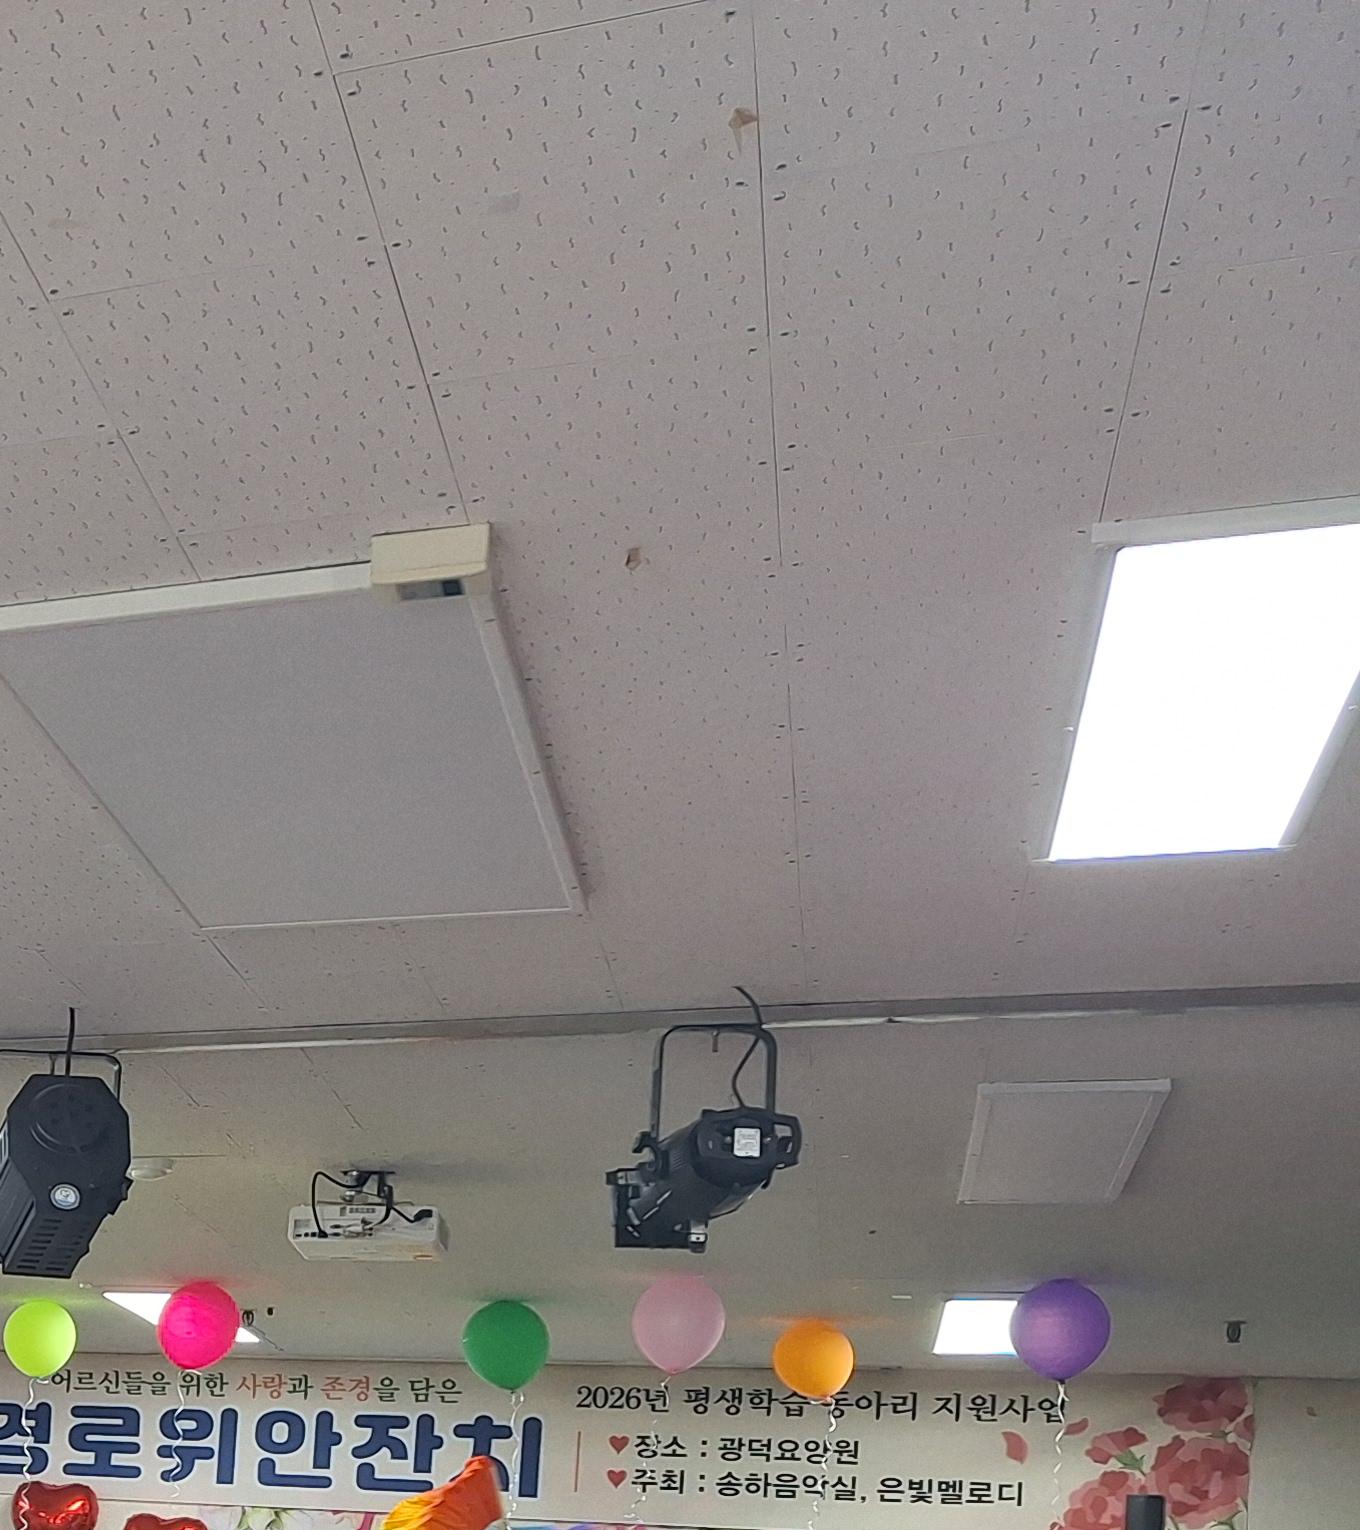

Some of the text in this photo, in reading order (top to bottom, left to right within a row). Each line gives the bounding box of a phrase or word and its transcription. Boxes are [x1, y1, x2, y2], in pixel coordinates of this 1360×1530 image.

[50, 1371, 463, 1404] 어르신들을 위한 사랑과 존경을 담은
[575, 1384, 671, 1414] 2026년
[682, 1386, 815, 1418] 평생학습
[931, 1391, 1066, 1425] 지원사업
[633, 1433, 689, 1459] 장소
[630, 1468, 686, 1495] 주최
[714, 1470, 868, 1504] 송하음악실,
[875, 1476, 1025, 1507] 은빛멜로디
